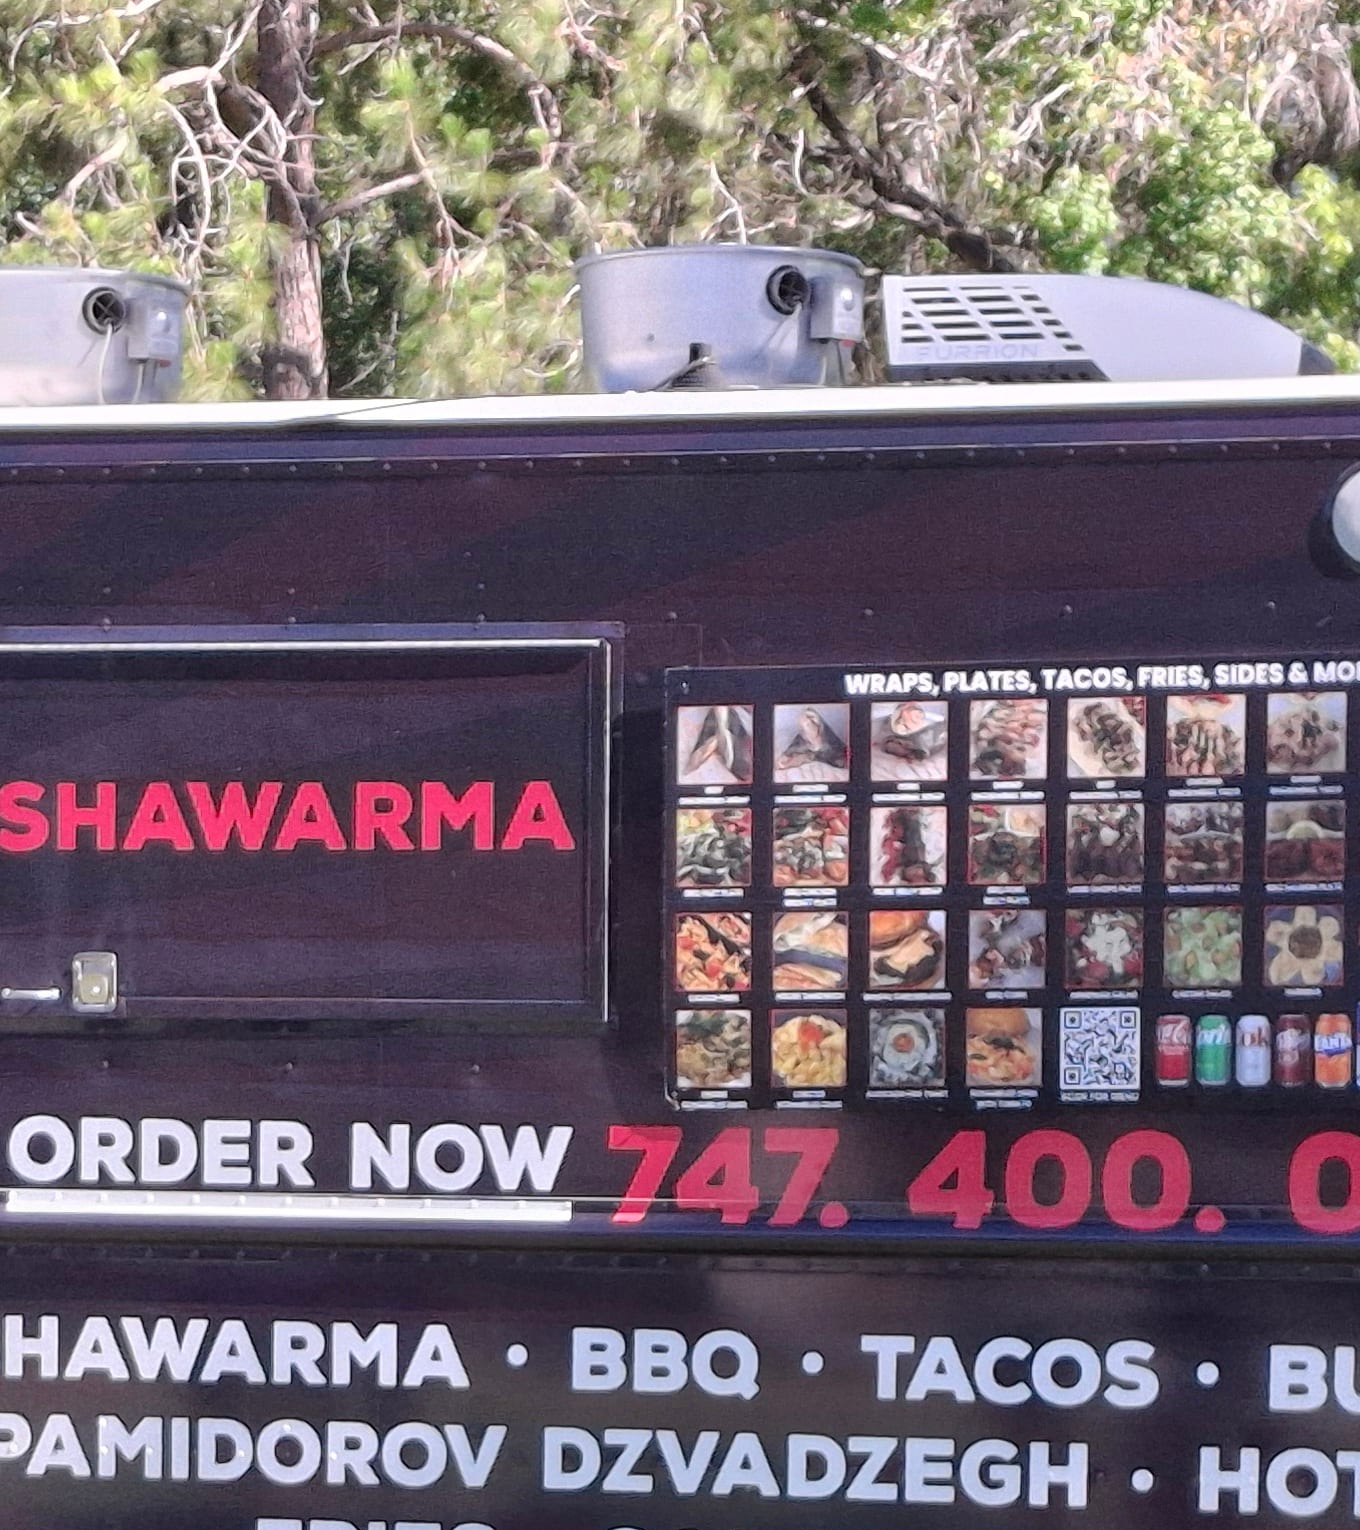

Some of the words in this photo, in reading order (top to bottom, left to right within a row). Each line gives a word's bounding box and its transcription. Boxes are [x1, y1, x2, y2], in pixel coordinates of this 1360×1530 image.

[844, 672, 940, 697] WRAPS,
[942, 669, 1038, 694] PLATES,
[1041, 667, 1133, 691] TACOS,
[1137, 664, 1211, 690] FRIES,
[1214, 662, 1285, 686] SIDES
[1288, 660, 1309, 684] &
[7, 1114, 316, 1187] ORDER
[349, 1122, 575, 1192] NOW
[604, 1123, 850, 1230] 747.
[906, 1128, 1226, 1235] 400.
[571, 1327, 760, 1401] BBQ
[860, 1334, 1160, 1408] TACOS
[543, 1426, 1089, 1509] DZVADZEGH
